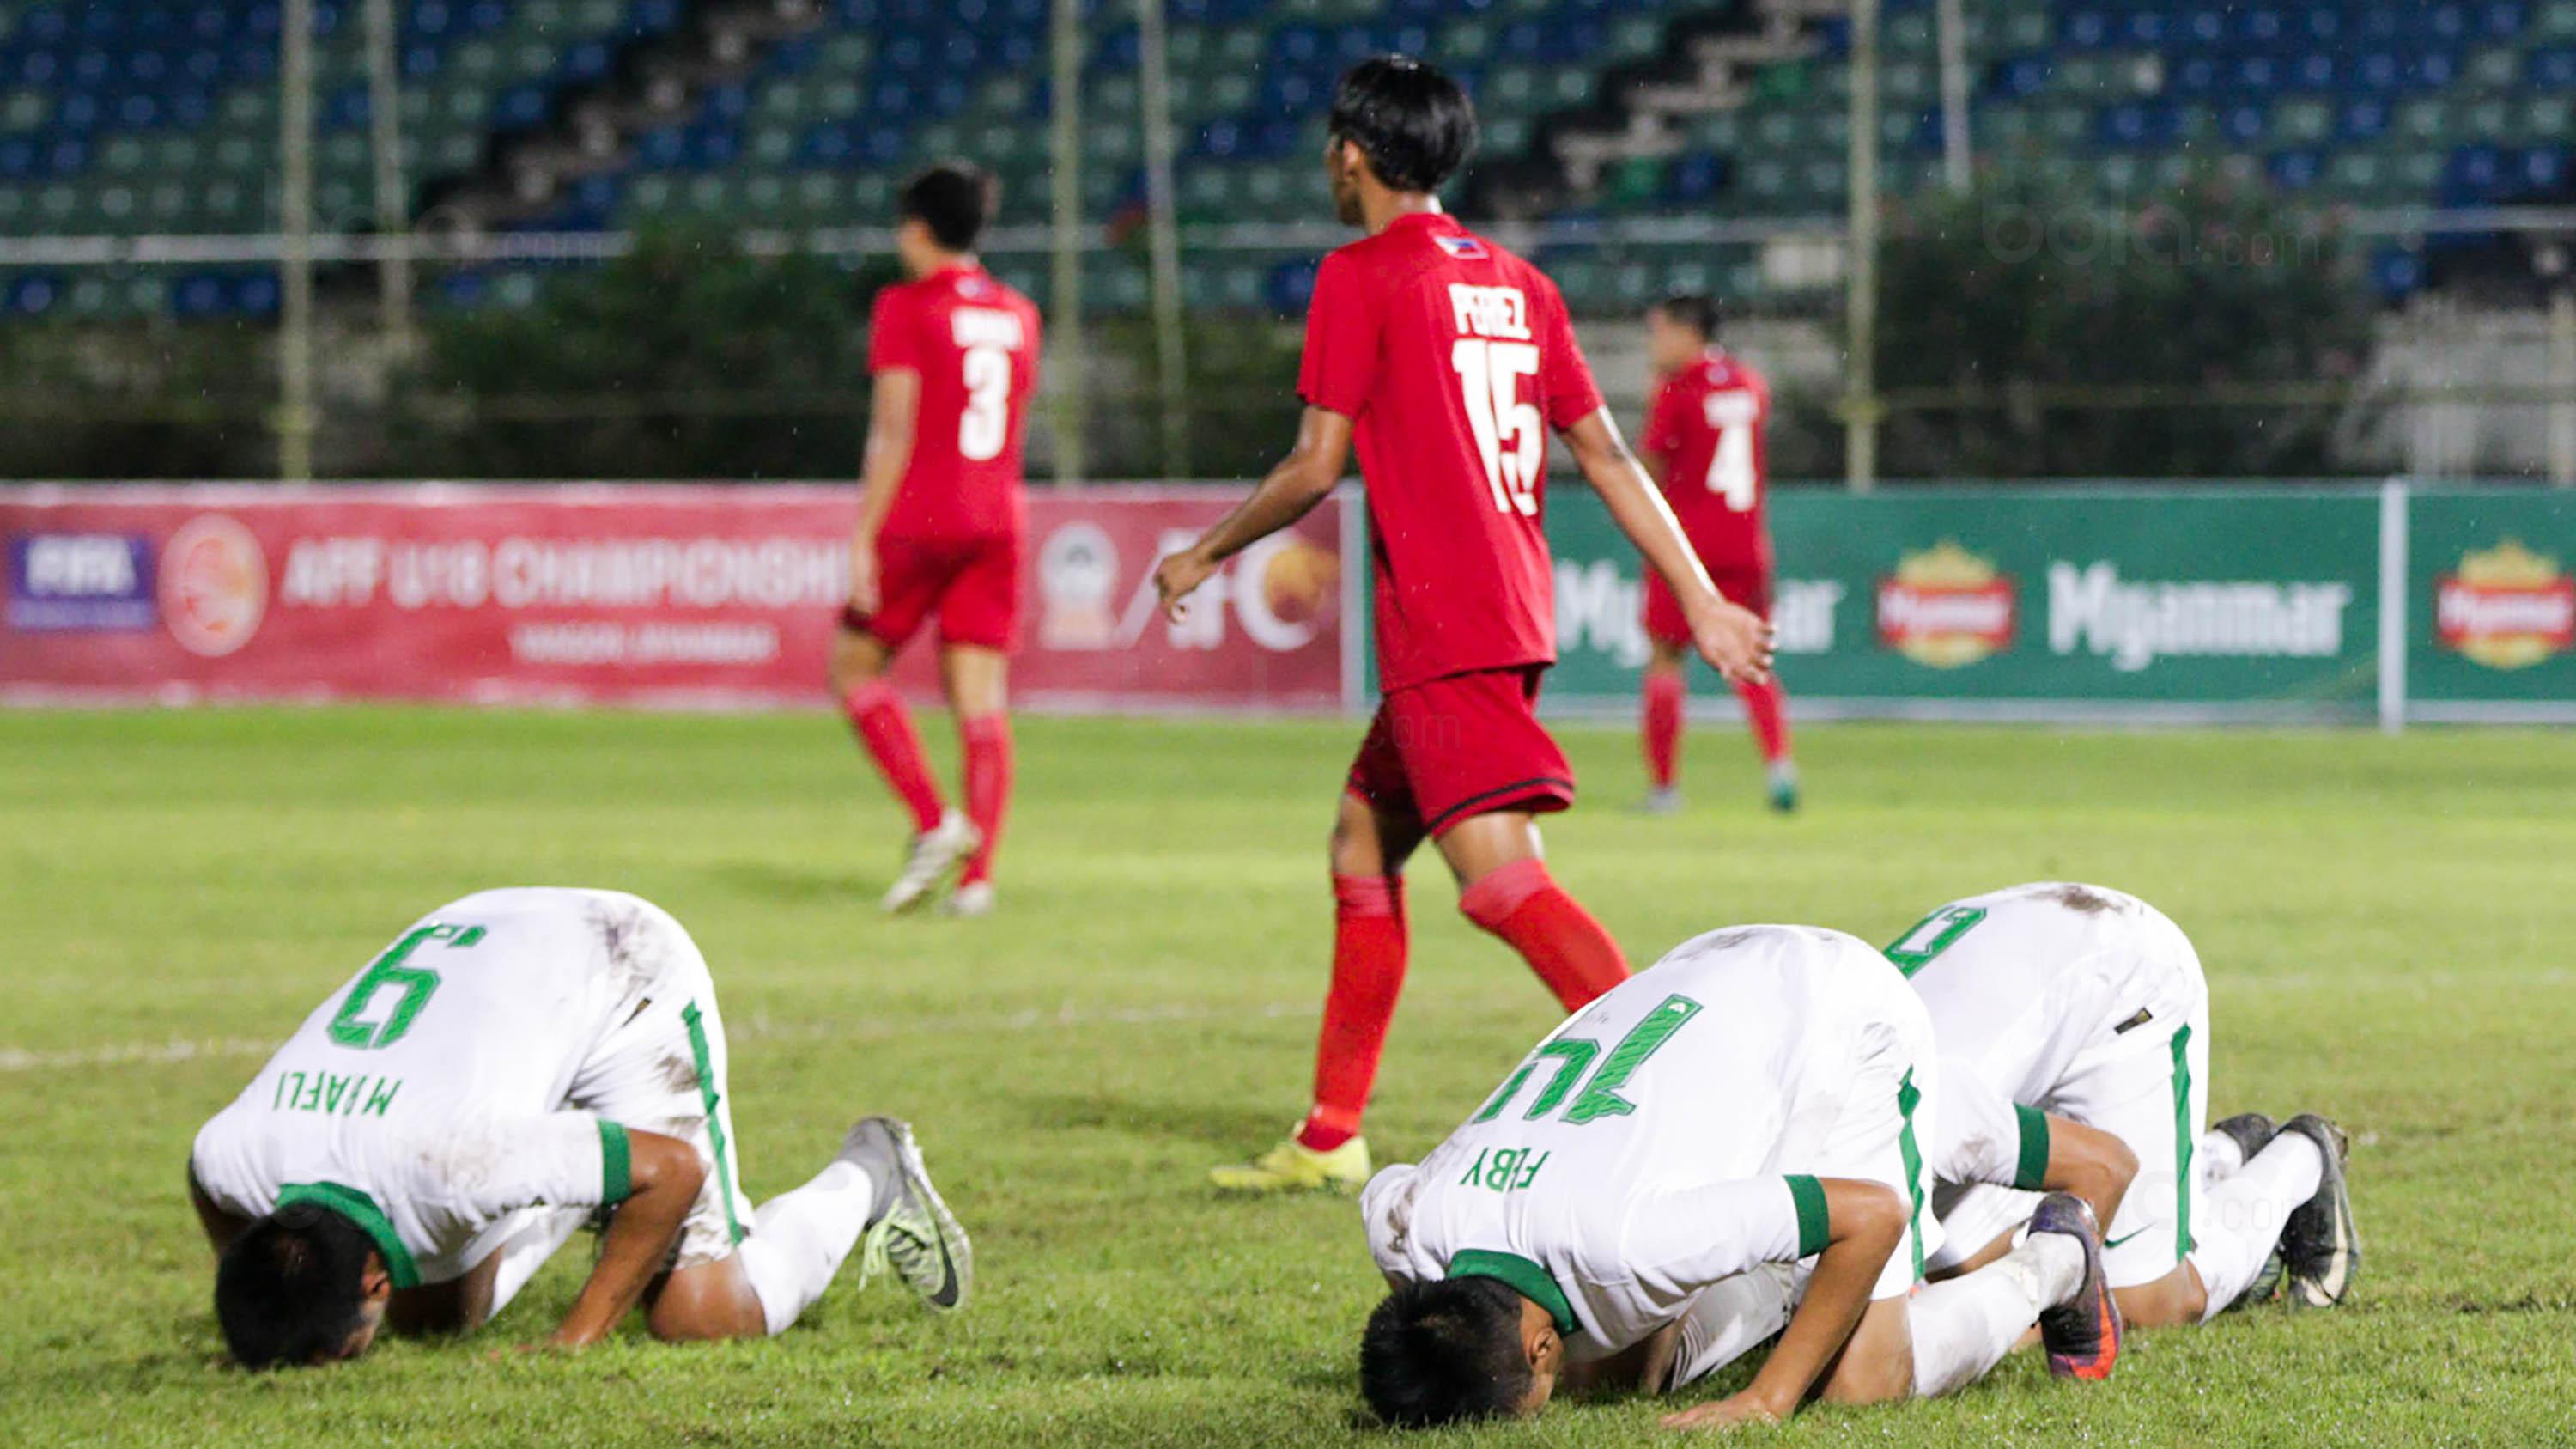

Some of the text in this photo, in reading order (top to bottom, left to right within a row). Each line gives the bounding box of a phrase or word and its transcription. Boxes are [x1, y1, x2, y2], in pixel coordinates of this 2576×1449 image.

[1448, 283, 1531, 340] PEREZ
[958, 345, 1012, 461] 3
[1451, 338, 1543, 517] 15
[1705, 423, 1757, 512] 4
[26, 535, 136, 594] FIFA
[281, 536, 385, 607] AFF
[491, 536, 852, 608] CHAMPIONSHI
[1554, 557, 1849, 670] Myar
[2048, 559, 2353, 671] Myanmar
